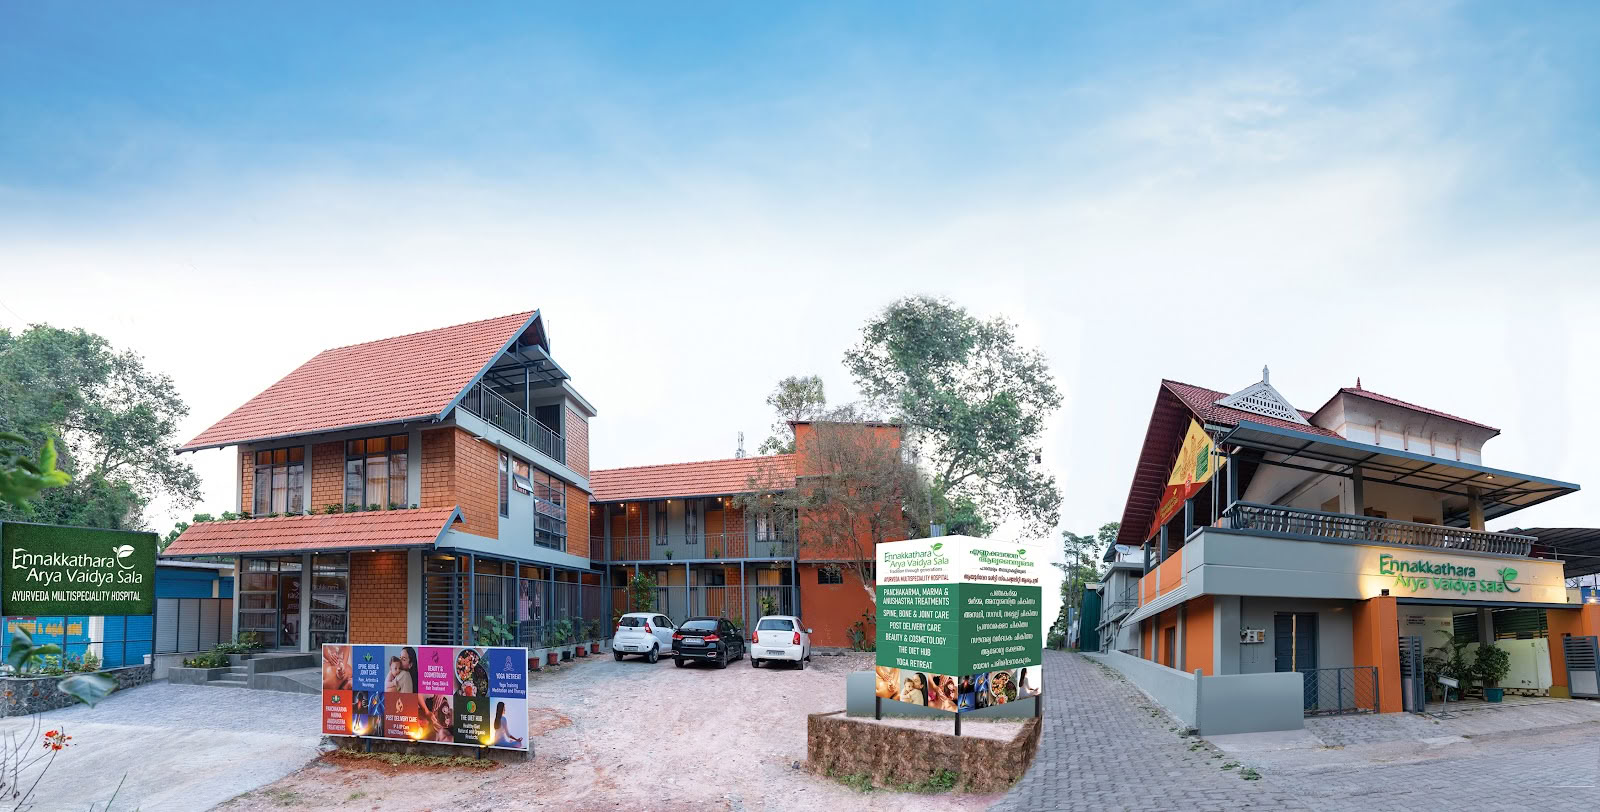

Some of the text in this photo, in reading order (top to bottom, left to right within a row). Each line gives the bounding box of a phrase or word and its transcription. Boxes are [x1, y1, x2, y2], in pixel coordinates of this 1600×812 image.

[12, 548, 115, 569] Ennakkathara
[884, 550, 932, 562] Ennakkathara
[890, 557, 949, 568] Arya Vaidya Sala
[1379, 553, 1476, 578] Ennakkathara
[26, 567, 143, 587] Arya Vaidya Sala
[1394, 573, 1505, 595] Arya Vaidya Sala
[11, 590, 141, 601] AYURVEDA MULTISPECIALITY HOSPITAL
[922, 588, 943, 596] MARMA
[943, 587, 949, 596] &
[883, 597, 950, 606] ANUSHASTRA TREATMENTS
[899, 609, 912, 618] BONE
[912, 610, 918, 618] &
[918, 611, 934, 619] JOINT
[935, 610, 950, 619] CARE
[889, 622, 942, 632] POST DELIVERY CARE
[885, 632, 947, 645] BEAUTY & COSMETOLOGY
[898, 645, 931, 656] THE DIET HUB
[896, 658, 933, 670] YOGA RETREAT
[495, 672, 506, 680] YOGA
